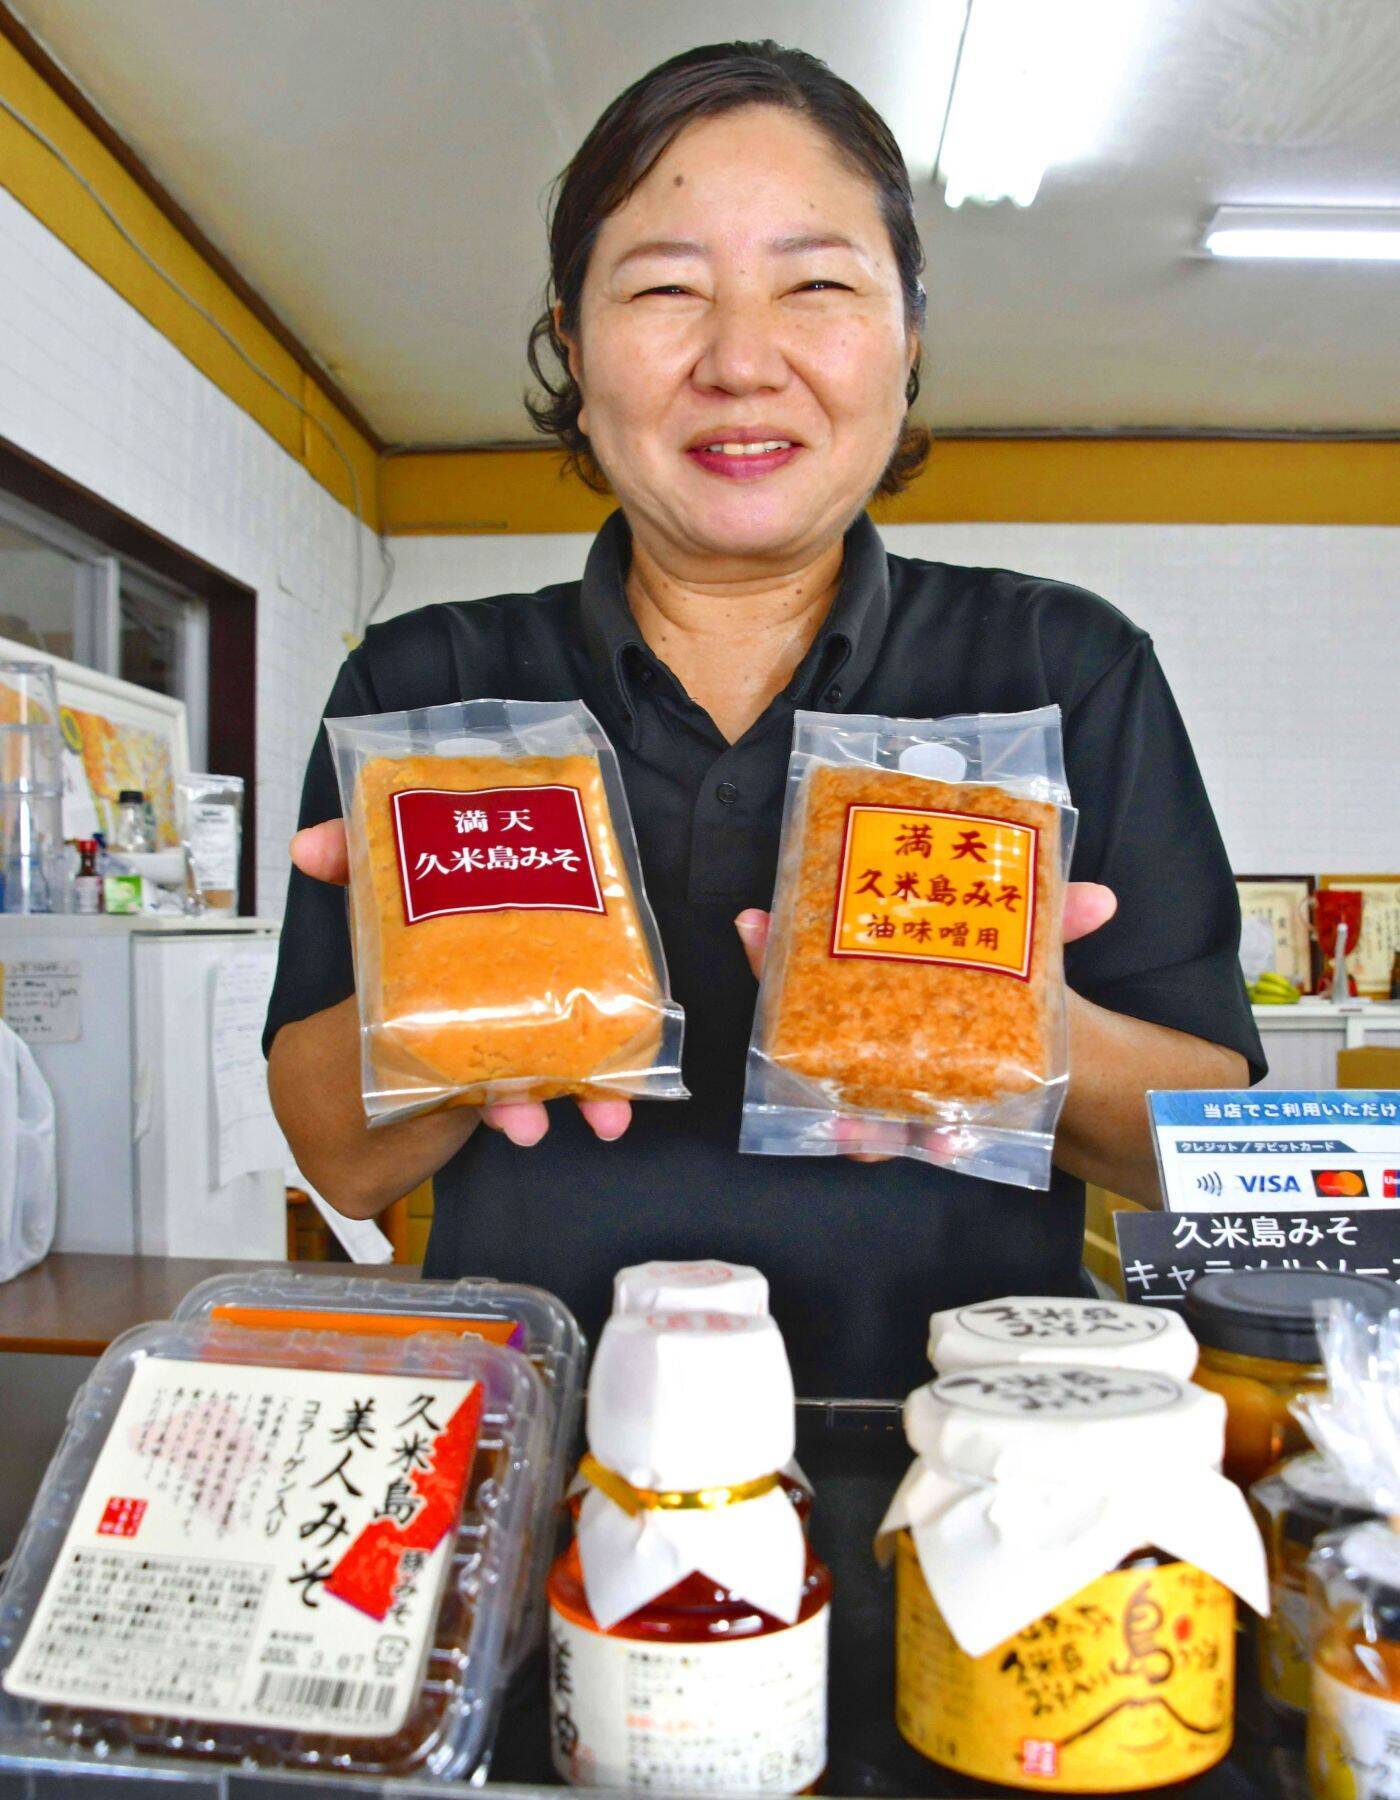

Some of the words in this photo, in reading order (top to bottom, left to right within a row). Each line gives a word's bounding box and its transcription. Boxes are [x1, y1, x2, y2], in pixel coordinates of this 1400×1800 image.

[453, 809, 534, 834] 満天
[414, 845, 582, 880] 久米島みそ
[854, 868, 1022, 913] 久米島みそ
[867, 913, 999, 951] 油味噌用
[1203, 1102, 1400, 1119] 当店でご利用いただけ
[1236, 1175, 1301, 1193] VISA
[1172, 1215, 1359, 1249] 久米島みそ
[264, 1399, 321, 1538] コラーゲン入り
[374, 1393, 441, 1524] 久米島
[288, 1397, 376, 1608] 美人みそ
